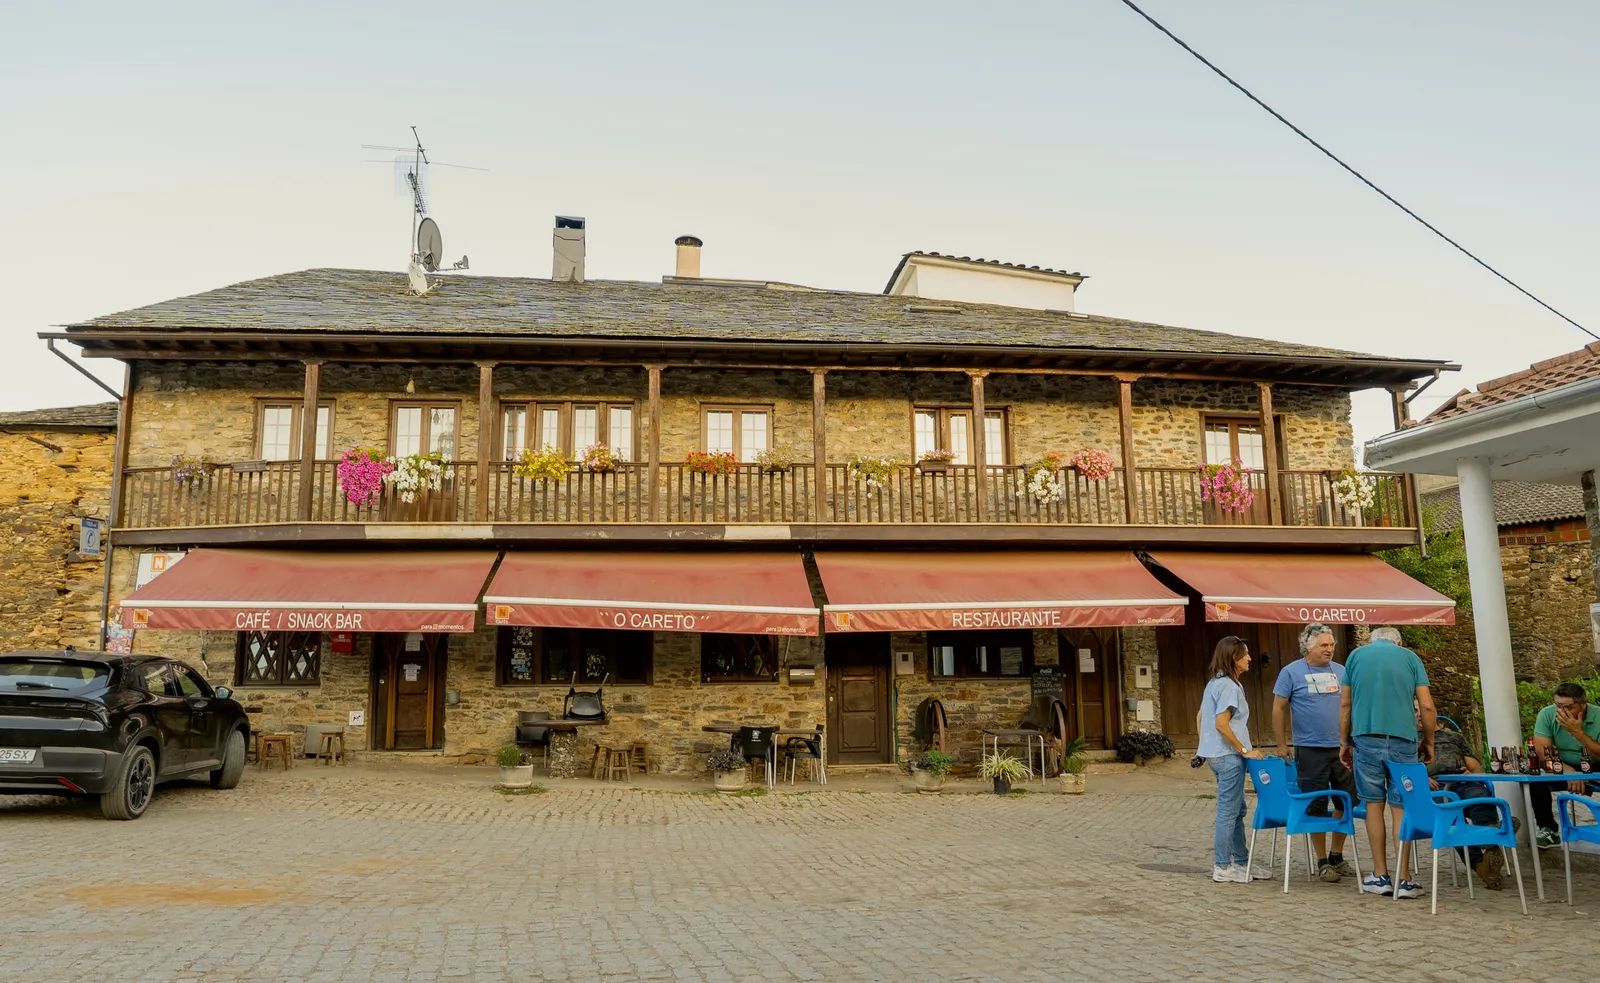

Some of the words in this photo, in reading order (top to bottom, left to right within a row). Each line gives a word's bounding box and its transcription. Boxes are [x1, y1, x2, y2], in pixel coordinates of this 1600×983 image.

[153, 556, 165, 570] N
[236, 610, 270, 628] CAFÉ
[287, 613, 332, 629] SNACK
[336, 613, 362, 629] BAR
[614, 613, 626, 627] O
[631, 613, 695, 629] CARETO
[952, 611, 1061, 627] RESTAURANTE
[1300, 608, 1309, 620] O
[1313, 608, 1365, 621] CARETO
